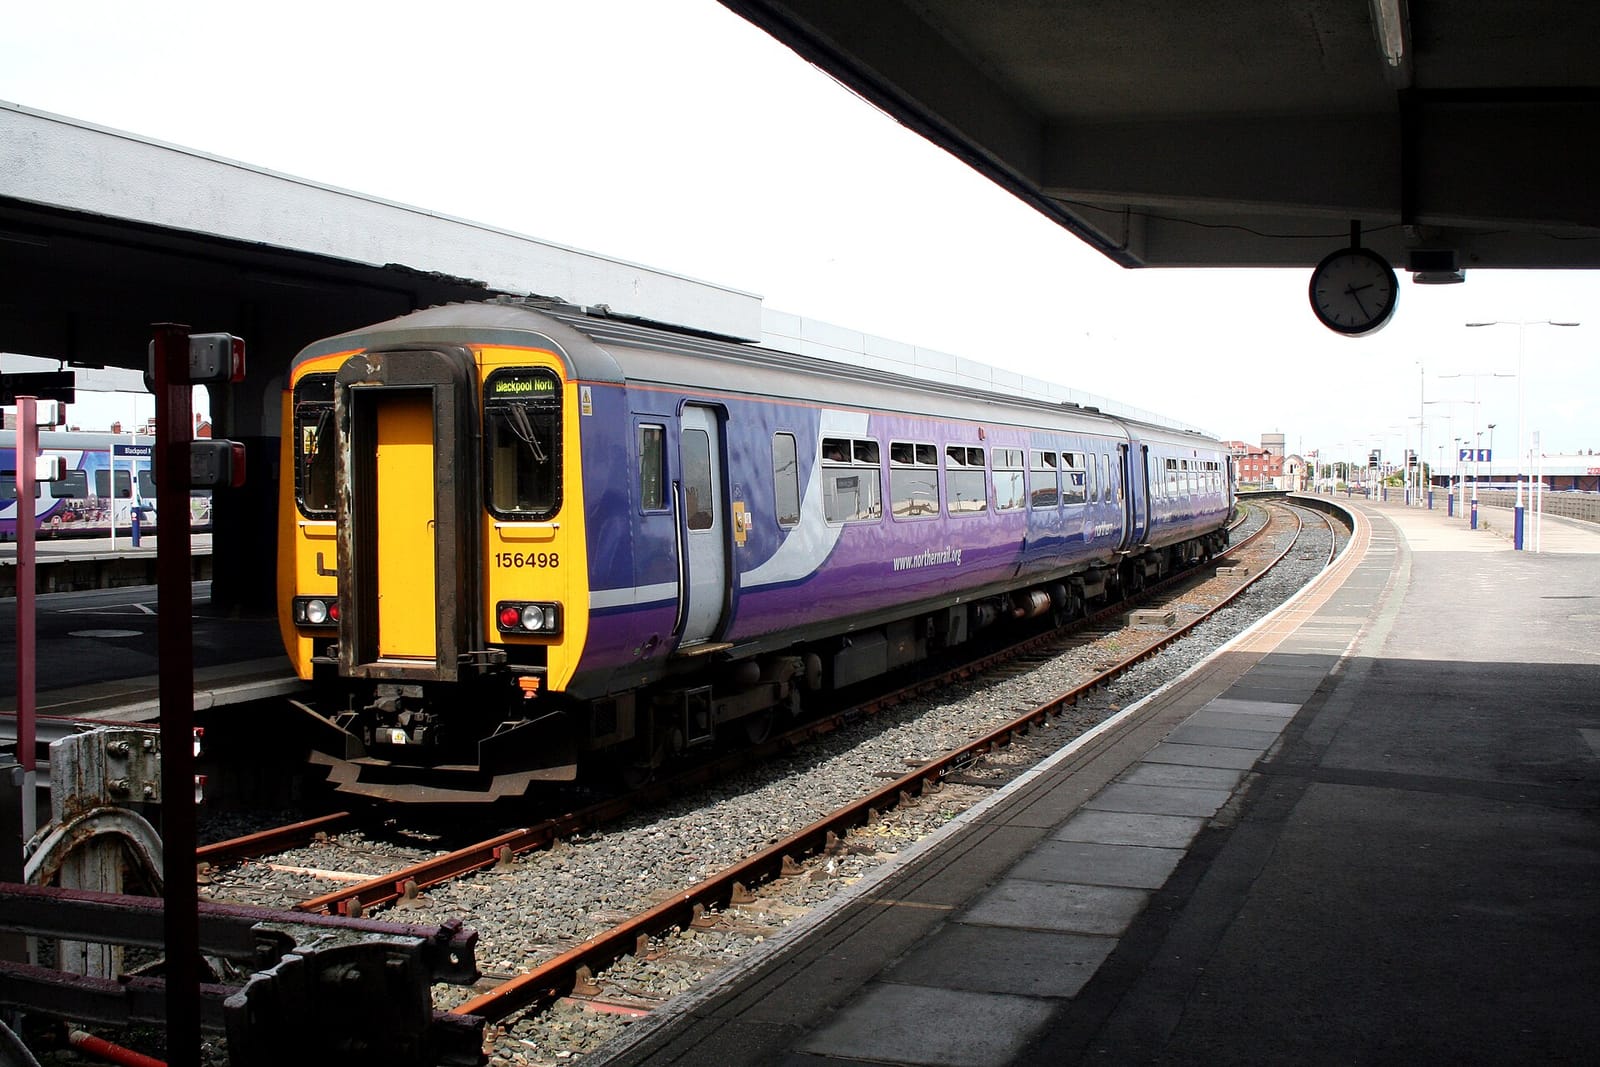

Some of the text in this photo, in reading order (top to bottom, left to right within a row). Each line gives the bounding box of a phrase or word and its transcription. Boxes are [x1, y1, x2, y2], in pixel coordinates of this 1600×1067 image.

[496, 380, 532, 394] Blackpool
[1462, 450, 1488, 462] 2 1
[495, 552, 559, 568] 156498
[893, 545, 962, 571] www.northernrail.org
